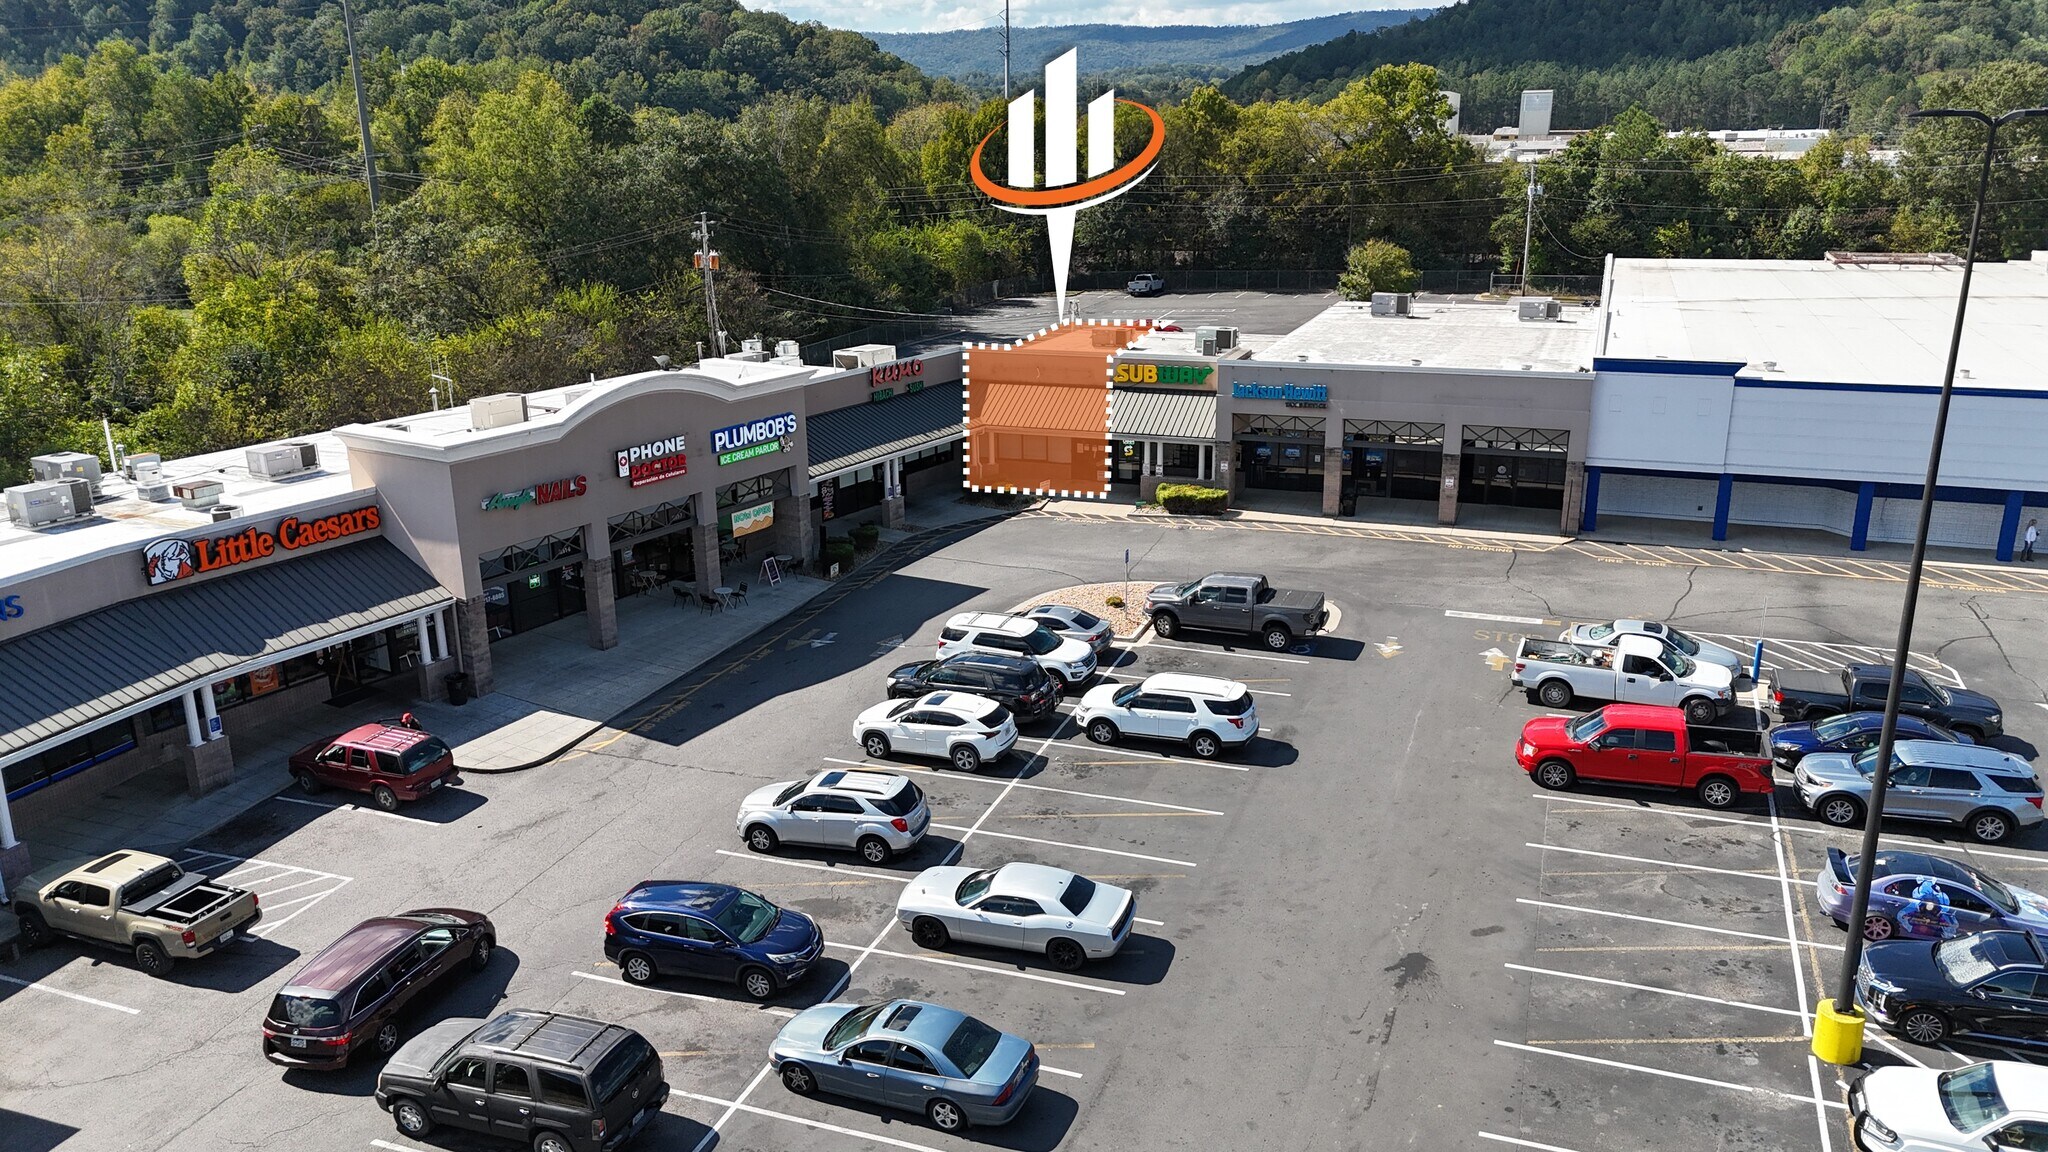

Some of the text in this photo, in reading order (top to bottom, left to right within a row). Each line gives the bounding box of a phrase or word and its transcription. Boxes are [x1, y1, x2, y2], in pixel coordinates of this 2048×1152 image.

[1113, 363, 1214, 385] SUBWAY
[1231, 381, 1328, 402] Jackson Hewitt
[714, 414, 797, 452] PLUMBOB'S
[629, 435, 686, 463] PHONE
[720, 442, 779, 465] ICE CREAM PARLOR
[631, 453, 687, 479] DOCTOR
[665, 469, 686, 478] Celulares
[535, 475, 587, 506] NAILS
[733, 504, 771, 523] NOW OPEN
[193, 505, 381, 573] Little Caesars
